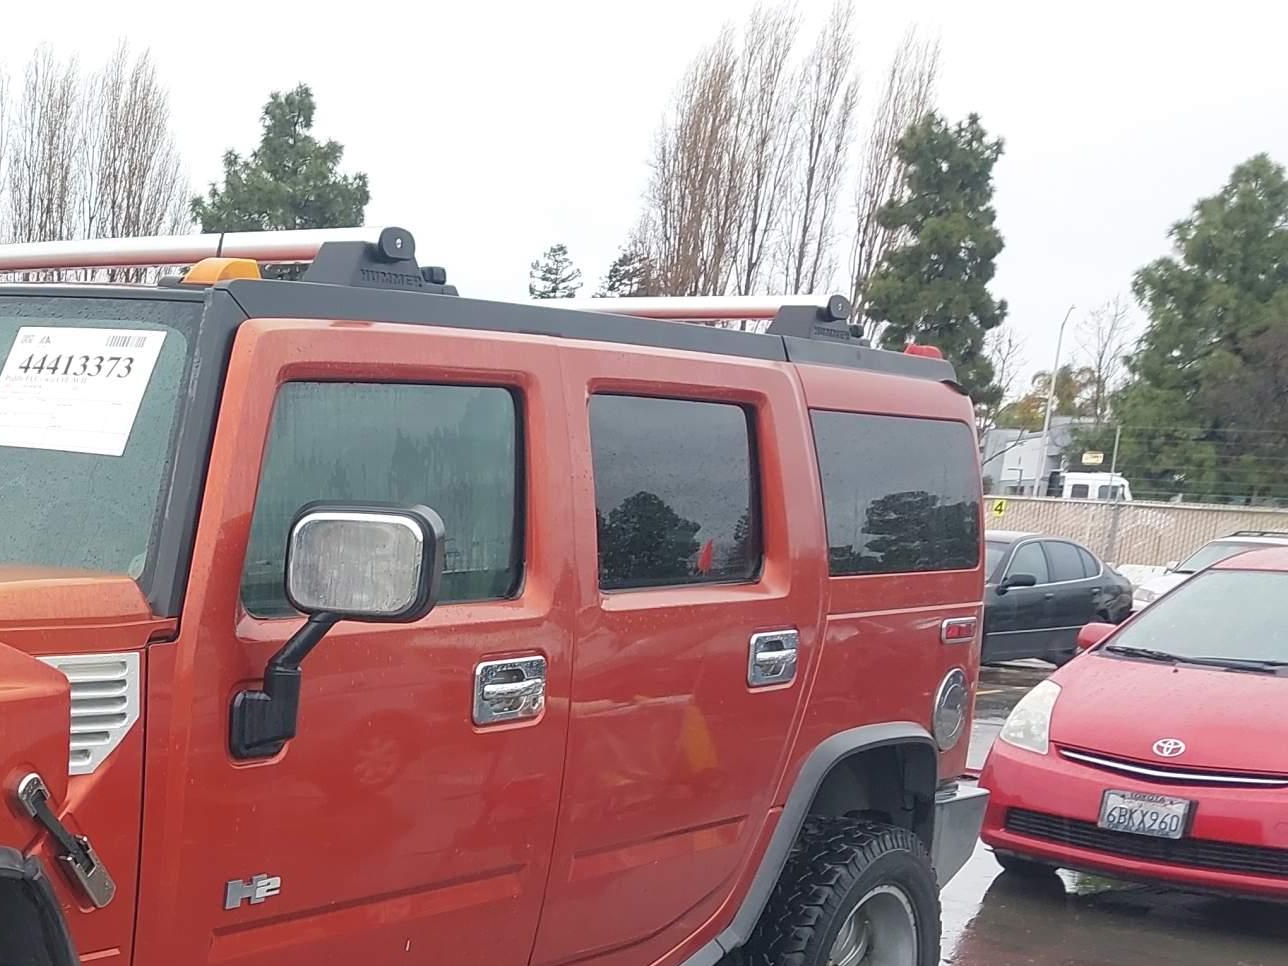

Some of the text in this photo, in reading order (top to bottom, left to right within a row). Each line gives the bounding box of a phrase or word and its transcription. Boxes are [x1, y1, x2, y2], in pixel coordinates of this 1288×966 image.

[18, 352, 135, 378] 44413373
[994, 501, 1003, 514] 4
[1106, 806, 1180, 833] 6BKX960
[225, 873, 281, 910] H2
